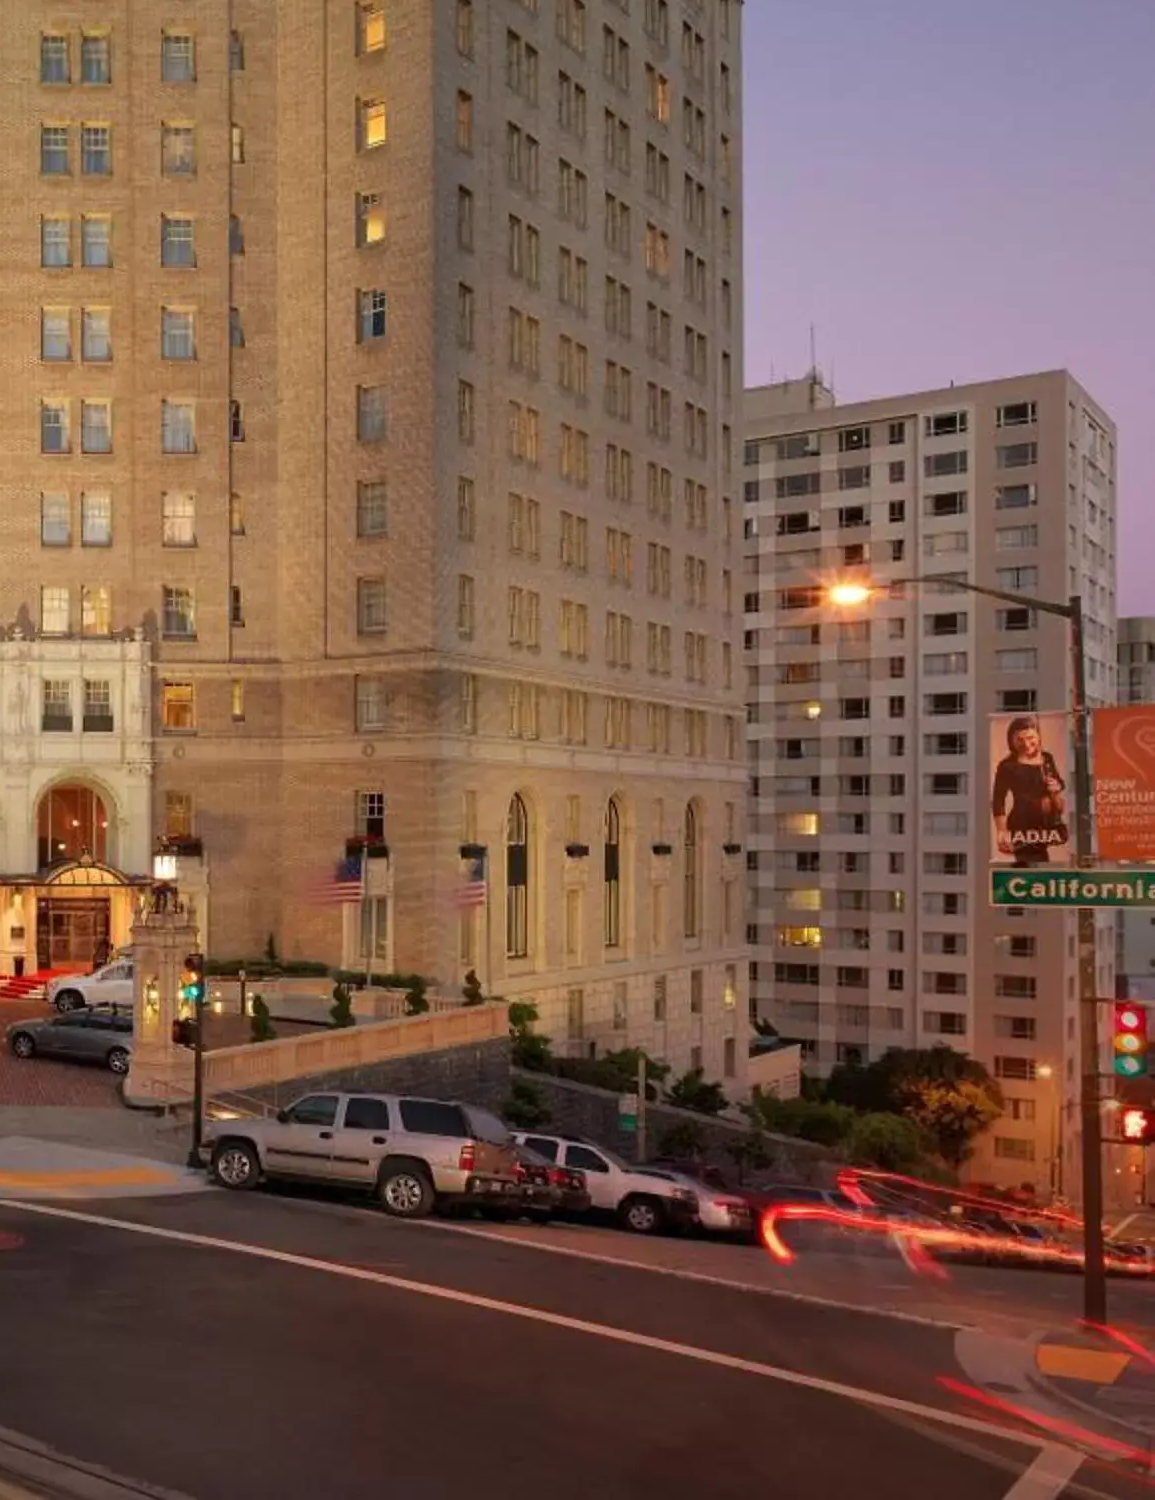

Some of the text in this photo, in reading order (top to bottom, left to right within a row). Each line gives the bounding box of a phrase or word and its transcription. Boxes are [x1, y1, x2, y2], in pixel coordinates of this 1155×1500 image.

[1096, 779, 1136, 791] New
[1096, 791, 1155, 804] Centur
[999, 829, 1062, 843] NADJA
